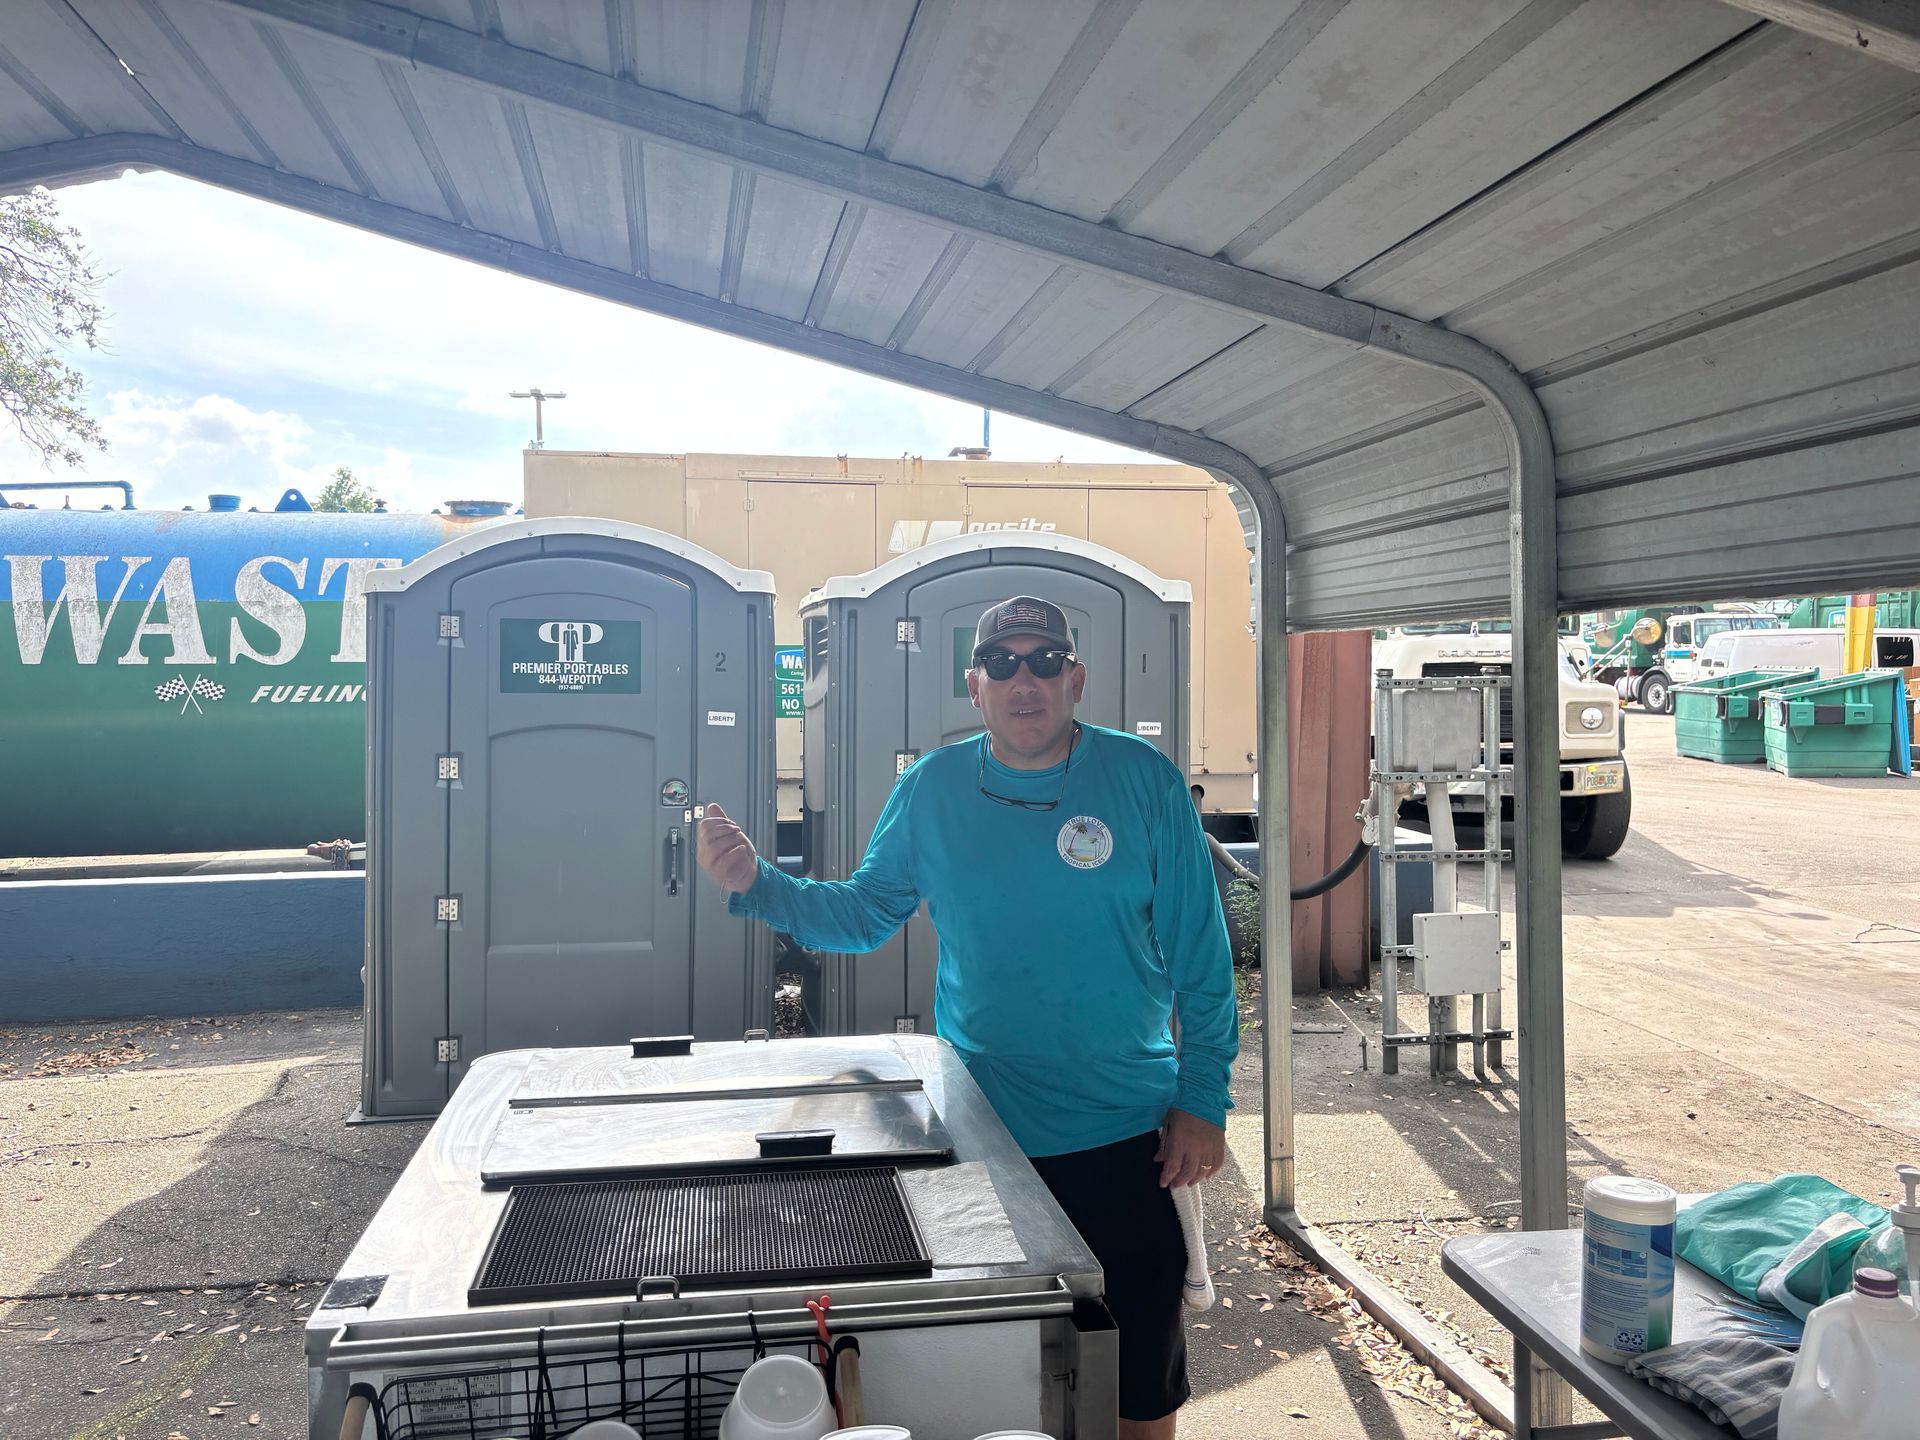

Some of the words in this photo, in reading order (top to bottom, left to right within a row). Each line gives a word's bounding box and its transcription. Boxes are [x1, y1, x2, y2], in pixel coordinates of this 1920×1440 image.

[512, 662, 561, 674] PREMIER
[564, 663, 629, 675] PORTABLES
[715, 652, 727, 672] 2
[538, 674, 603, 685] 844-WEPOTTY
[251, 685, 366, 703] FUELIN
[782, 699, 800, 709] NO
[1067, 817, 1085, 826] TRUE
[1087, 817, 1105, 830] LOVE
[1063, 853, 1091, 868] TROPICAL
[1092, 857, 1105, 866] ICES
